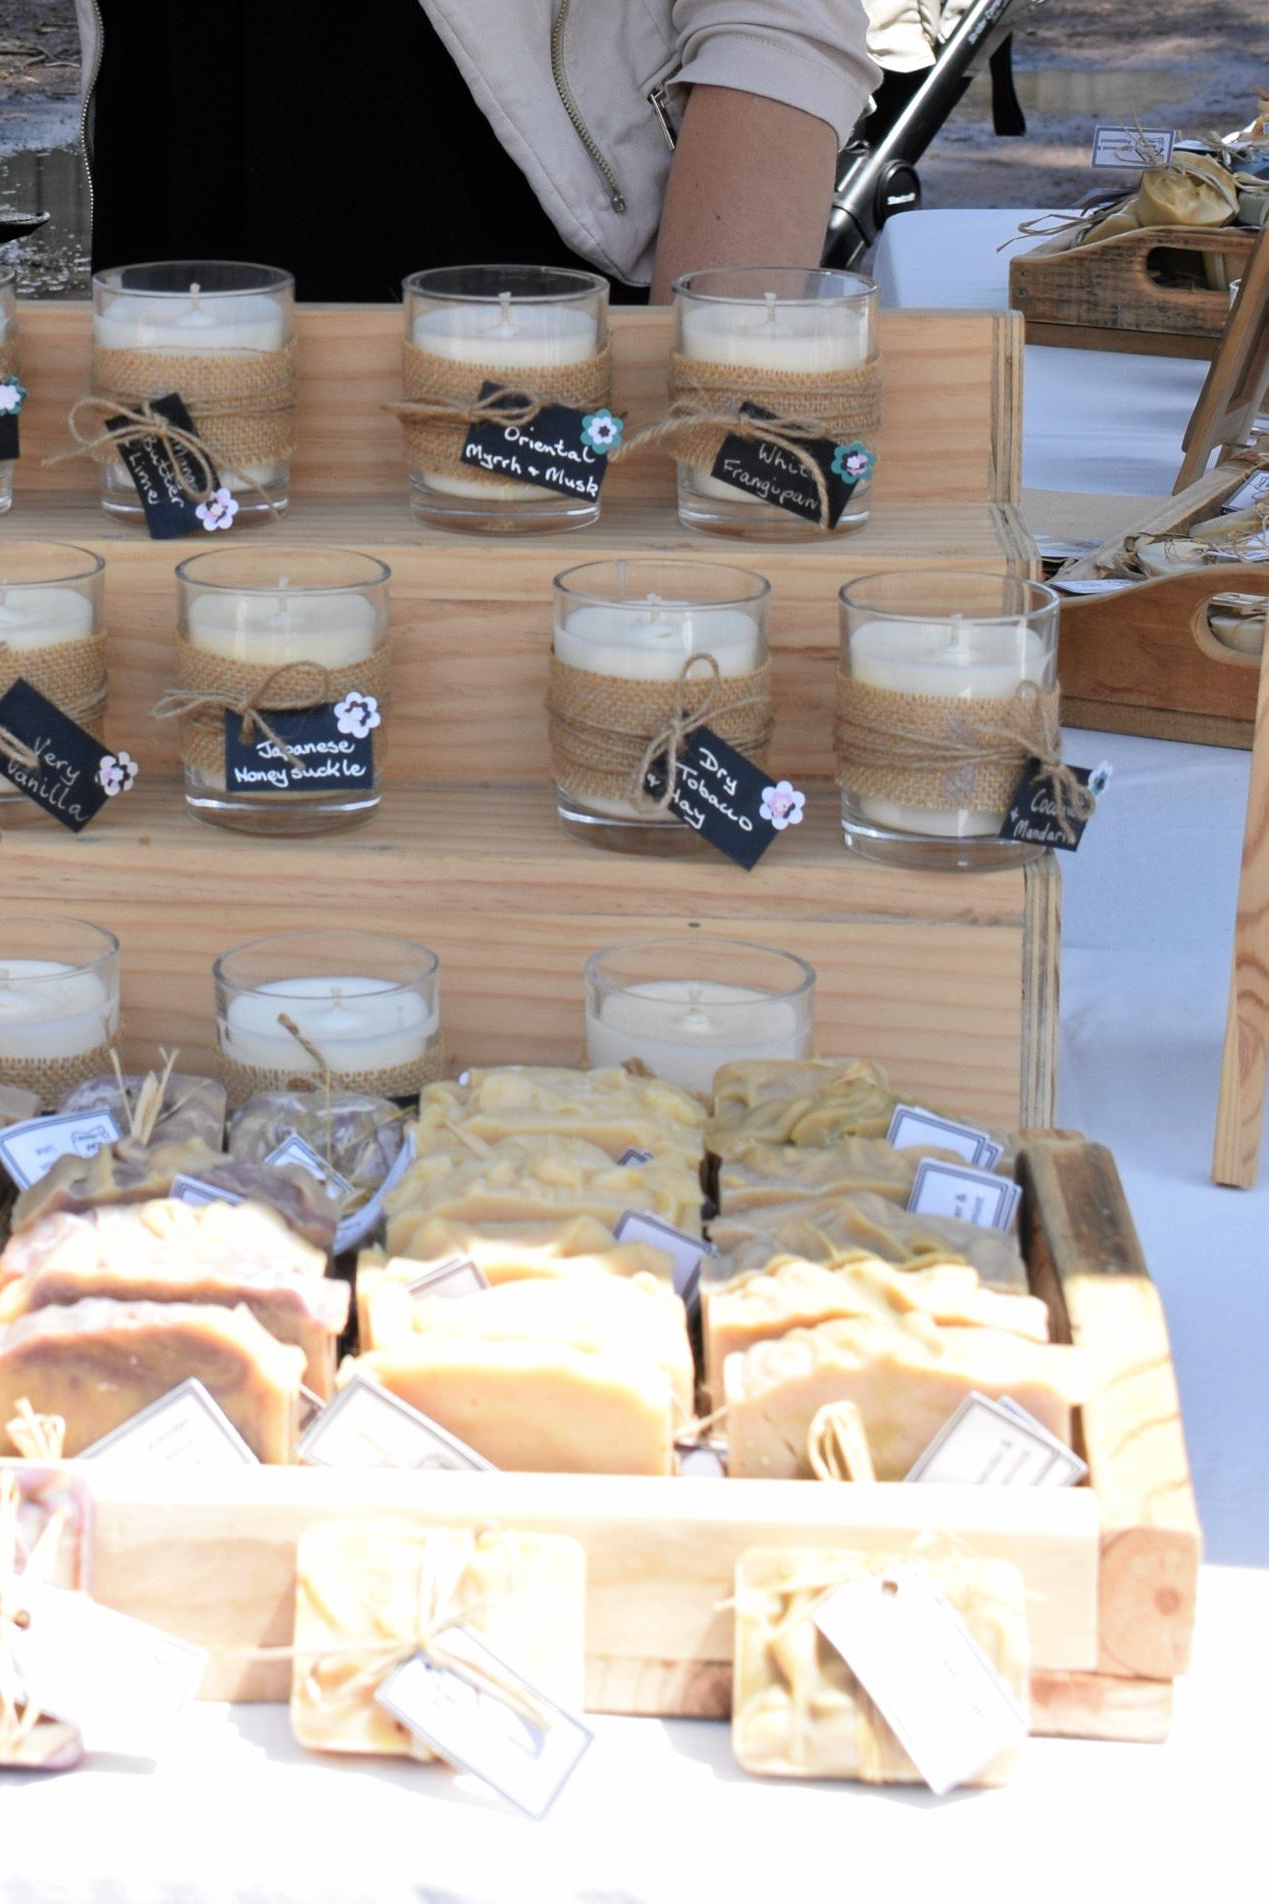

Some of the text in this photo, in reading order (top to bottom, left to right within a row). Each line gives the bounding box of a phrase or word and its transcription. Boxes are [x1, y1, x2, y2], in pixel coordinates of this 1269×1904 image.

[504, 426, 595, 463] Oriental
[759, 443, 811, 478] Whit
[129, 452, 160, 505] Lime
[466, 444, 521, 474] Myrrh
[545, 467, 599, 497] Musk
[724, 459, 819, 510] Frangipan
[33, 736, 81, 786] Very
[256, 740, 355, 762] Japanese
[699, 747, 737, 796] Dry
[8, 759, 89, 821] Vanilla
[675, 762, 753, 831] Tobacco
